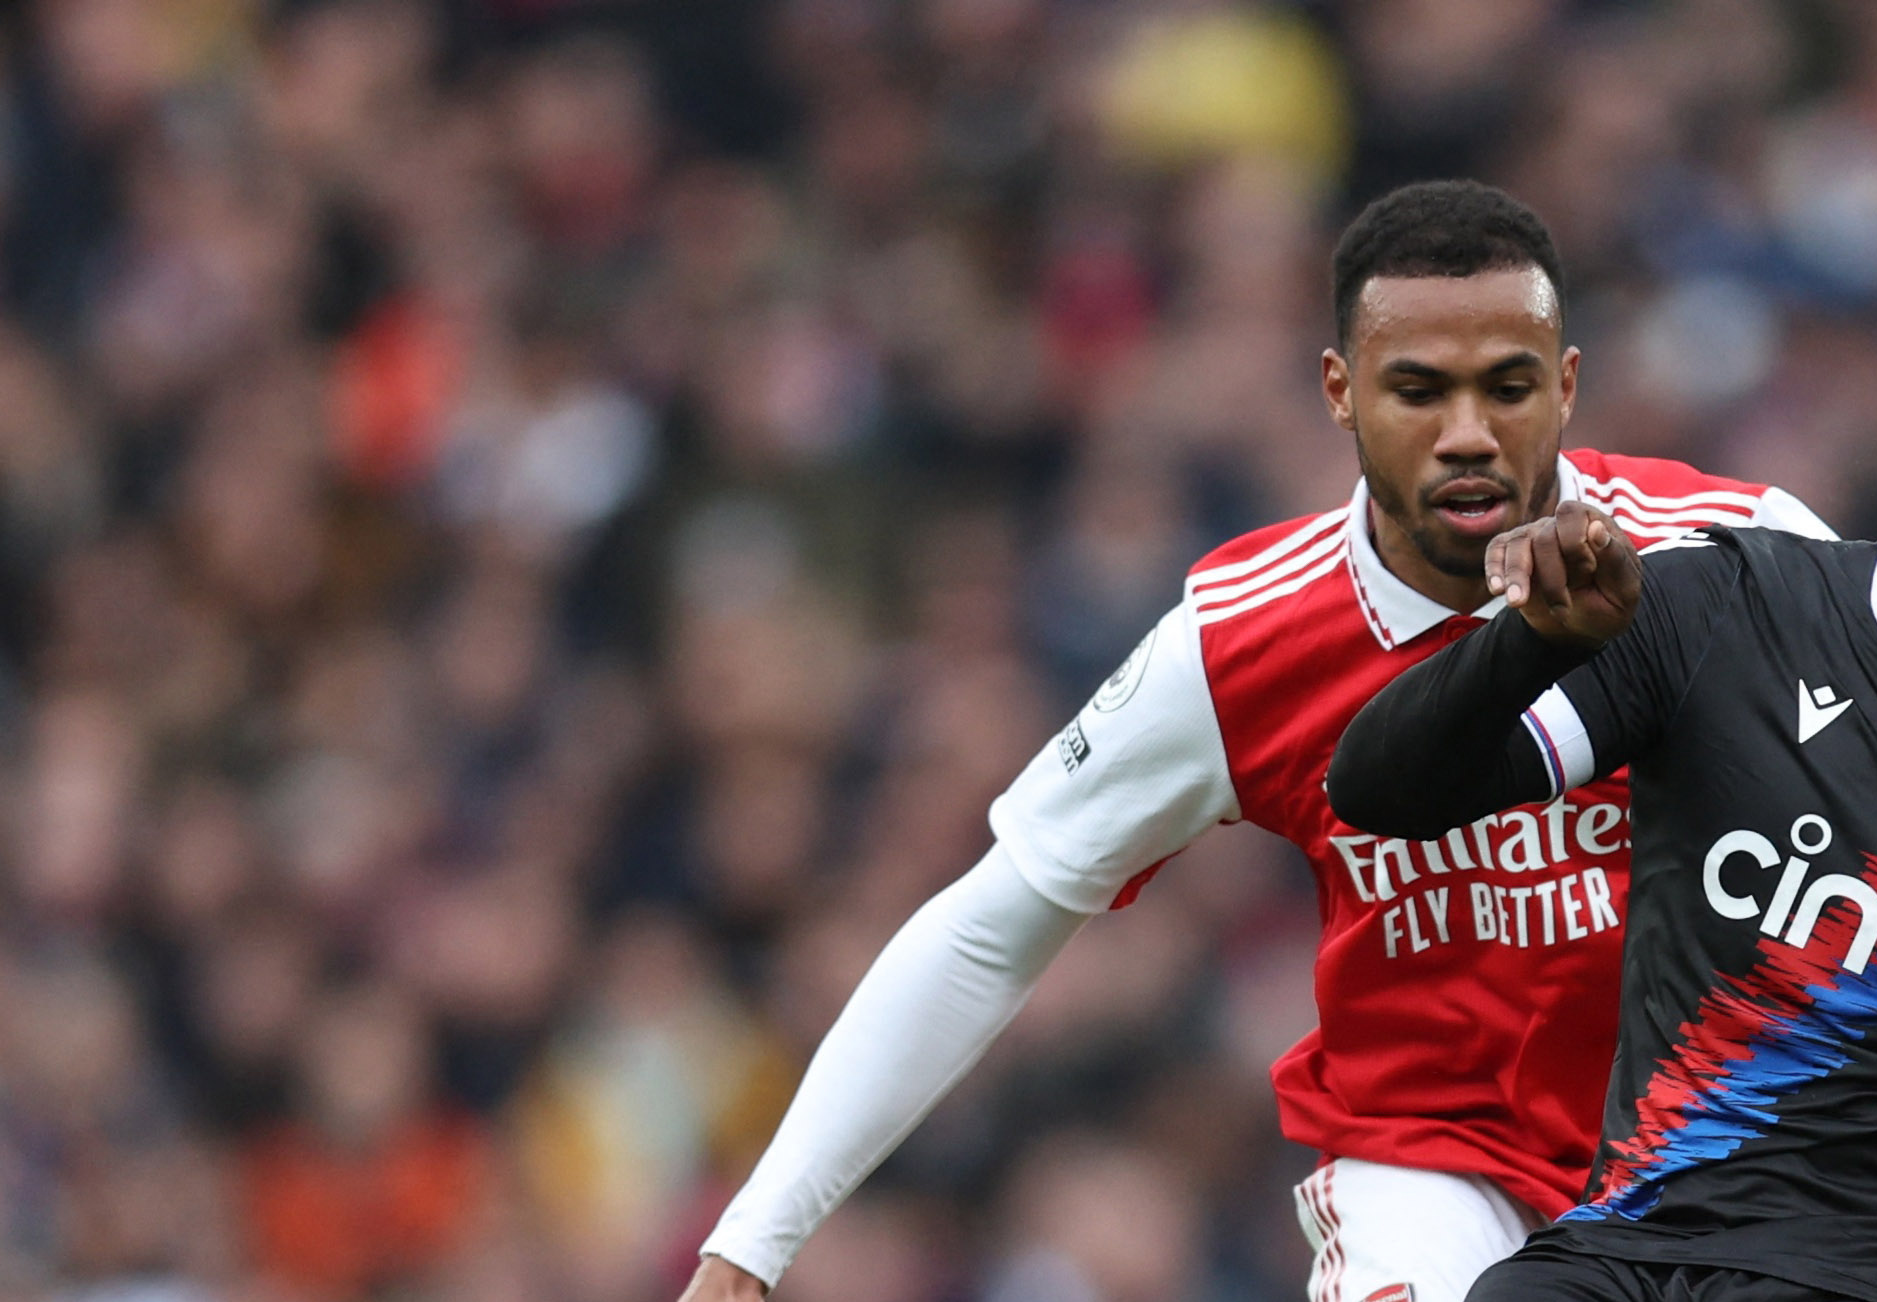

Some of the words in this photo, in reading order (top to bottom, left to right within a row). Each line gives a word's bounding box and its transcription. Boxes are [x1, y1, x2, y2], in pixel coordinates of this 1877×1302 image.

[1329, 796, 1632, 903] Emirate
[1383, 887, 1450, 959] FLY
[1470, 867, 1620, 948] BETTER
